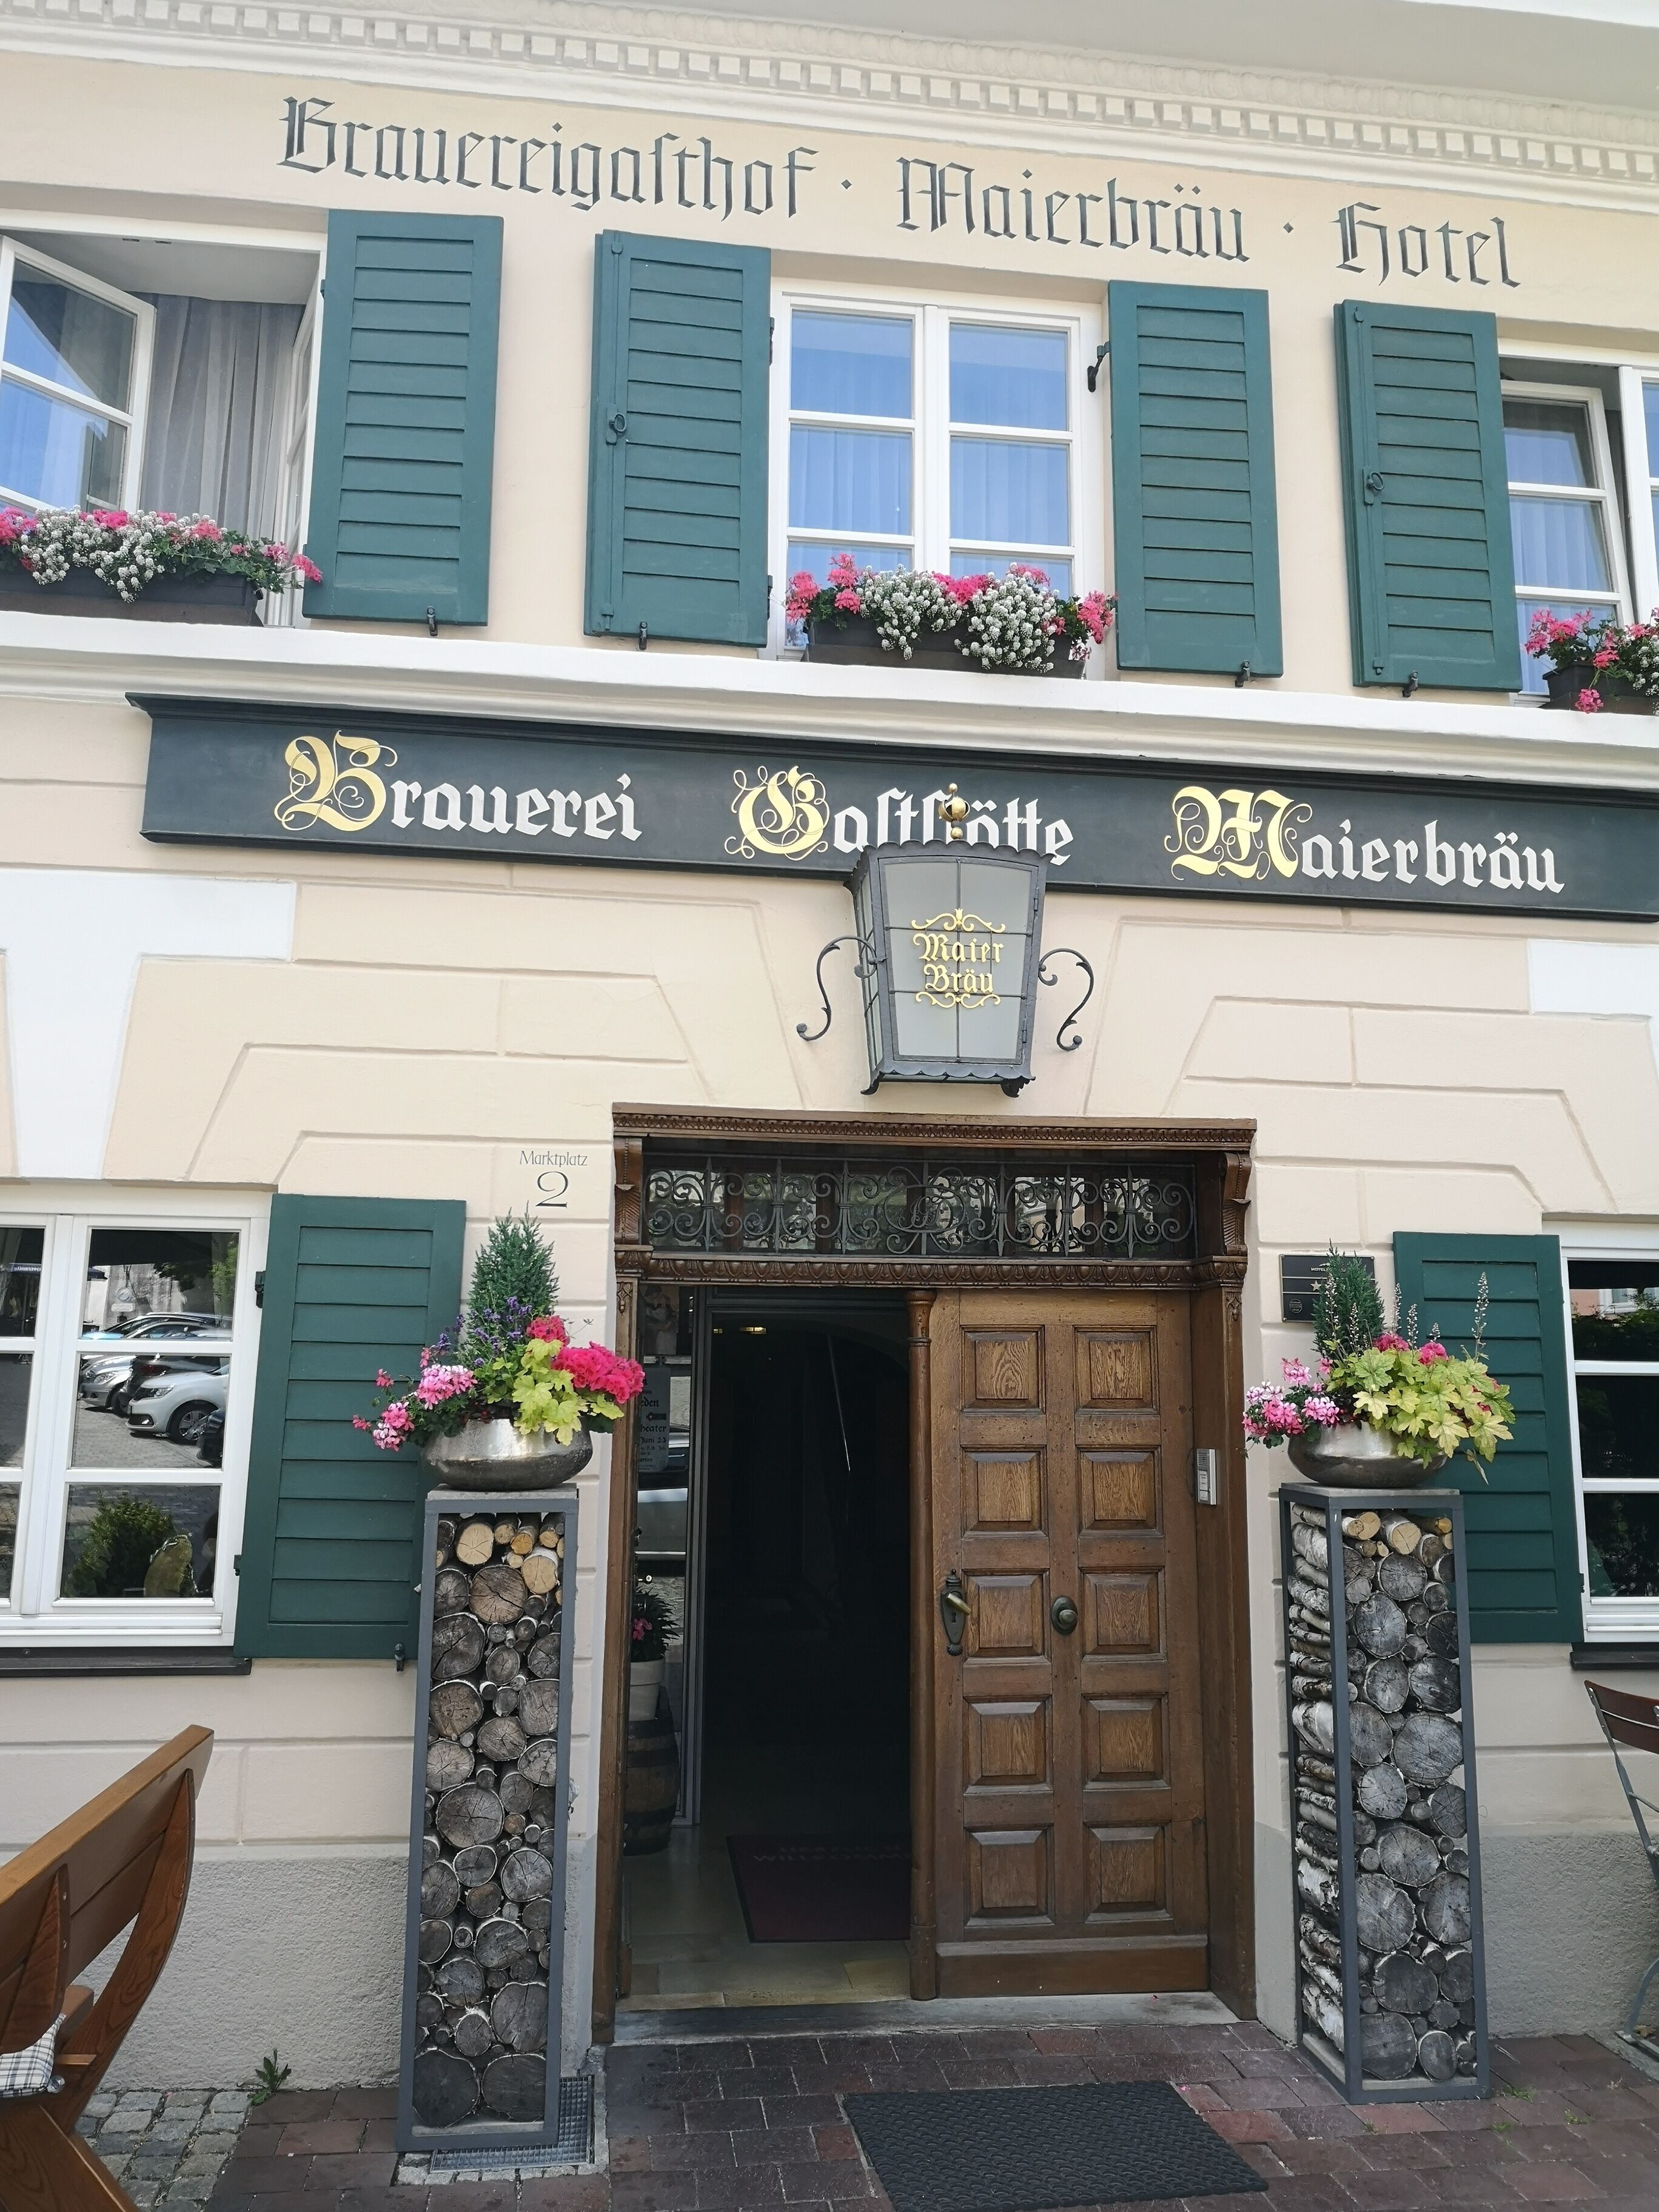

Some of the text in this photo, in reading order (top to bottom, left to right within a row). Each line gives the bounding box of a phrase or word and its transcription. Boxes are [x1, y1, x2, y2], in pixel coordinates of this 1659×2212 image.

[896, 156, 1250, 262] Maierbräu
[1329, 201, 1521, 287] Hotel
[273, 729, 643, 841] Brauerei
[1164, 786, 1565, 894] Maierbräu
[913, 933, 1005, 963] Maier
[923, 964, 994, 993] Bräu
[519, 1150, 588, 1168] Marktplatz
[535, 1171, 569, 1208] 2
